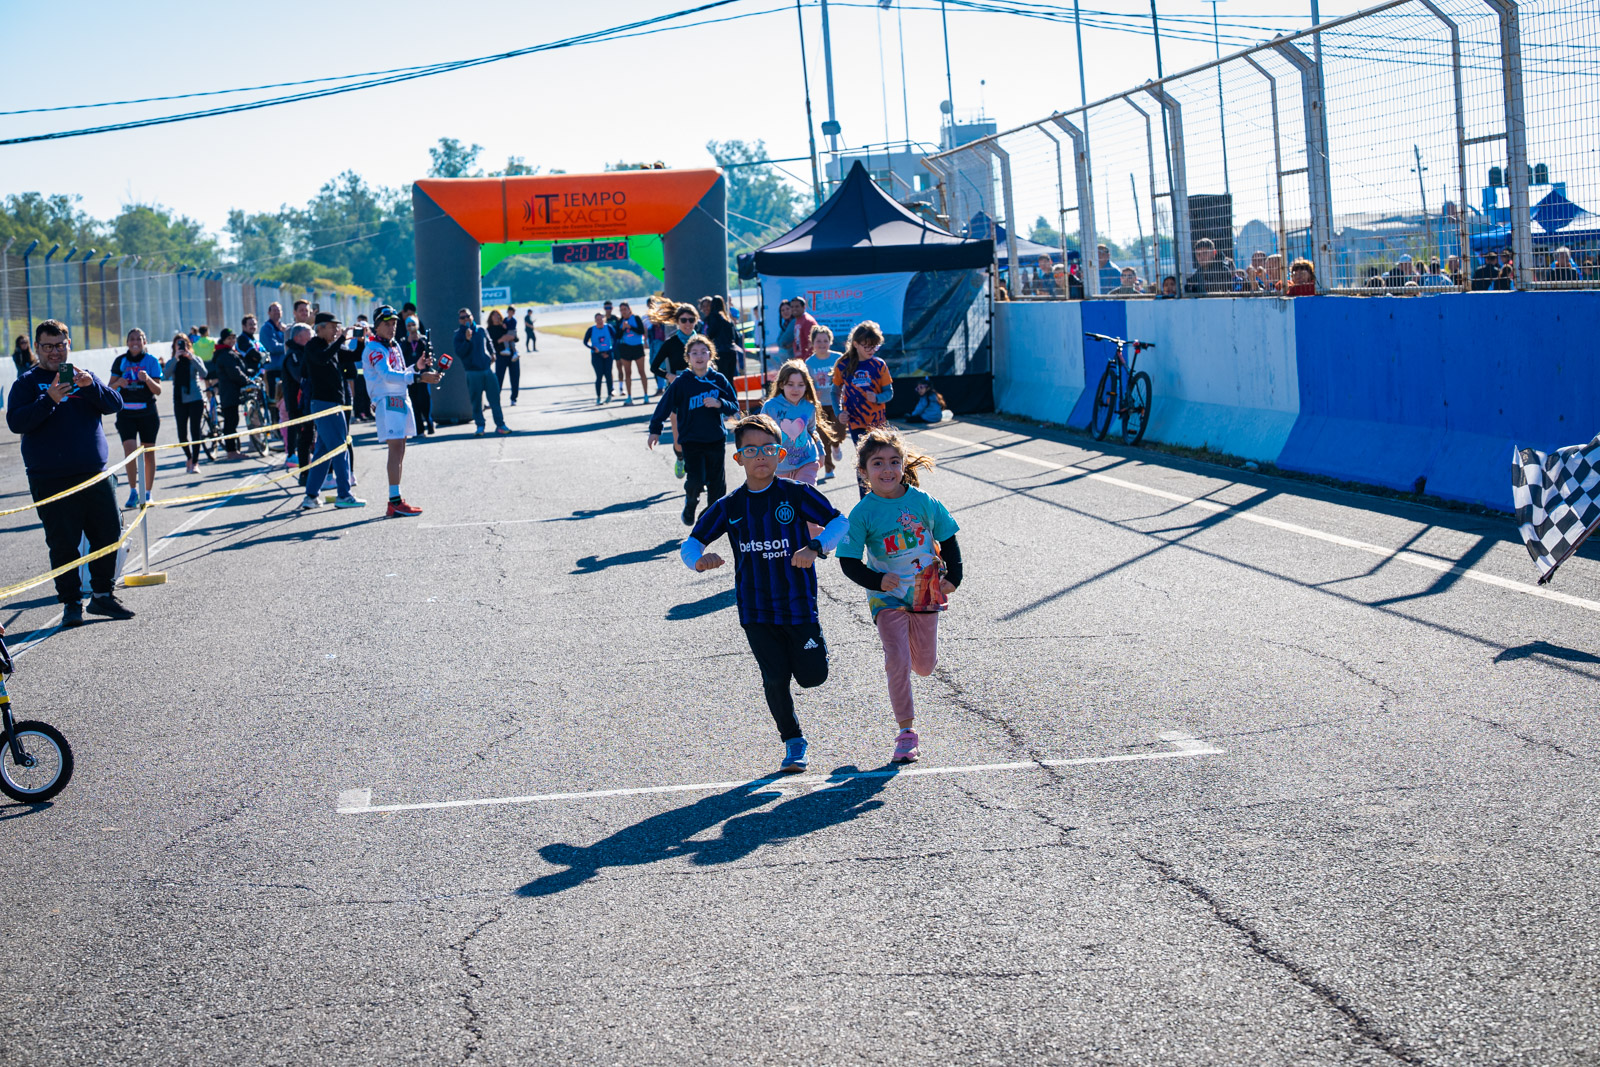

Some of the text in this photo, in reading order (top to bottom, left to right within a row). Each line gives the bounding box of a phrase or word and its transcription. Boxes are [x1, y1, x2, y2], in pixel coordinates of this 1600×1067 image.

[550, 199, 627, 224] EXACTO
[564, 242, 627, 263] 2:01:20
[739, 538, 790, 553] betsson
